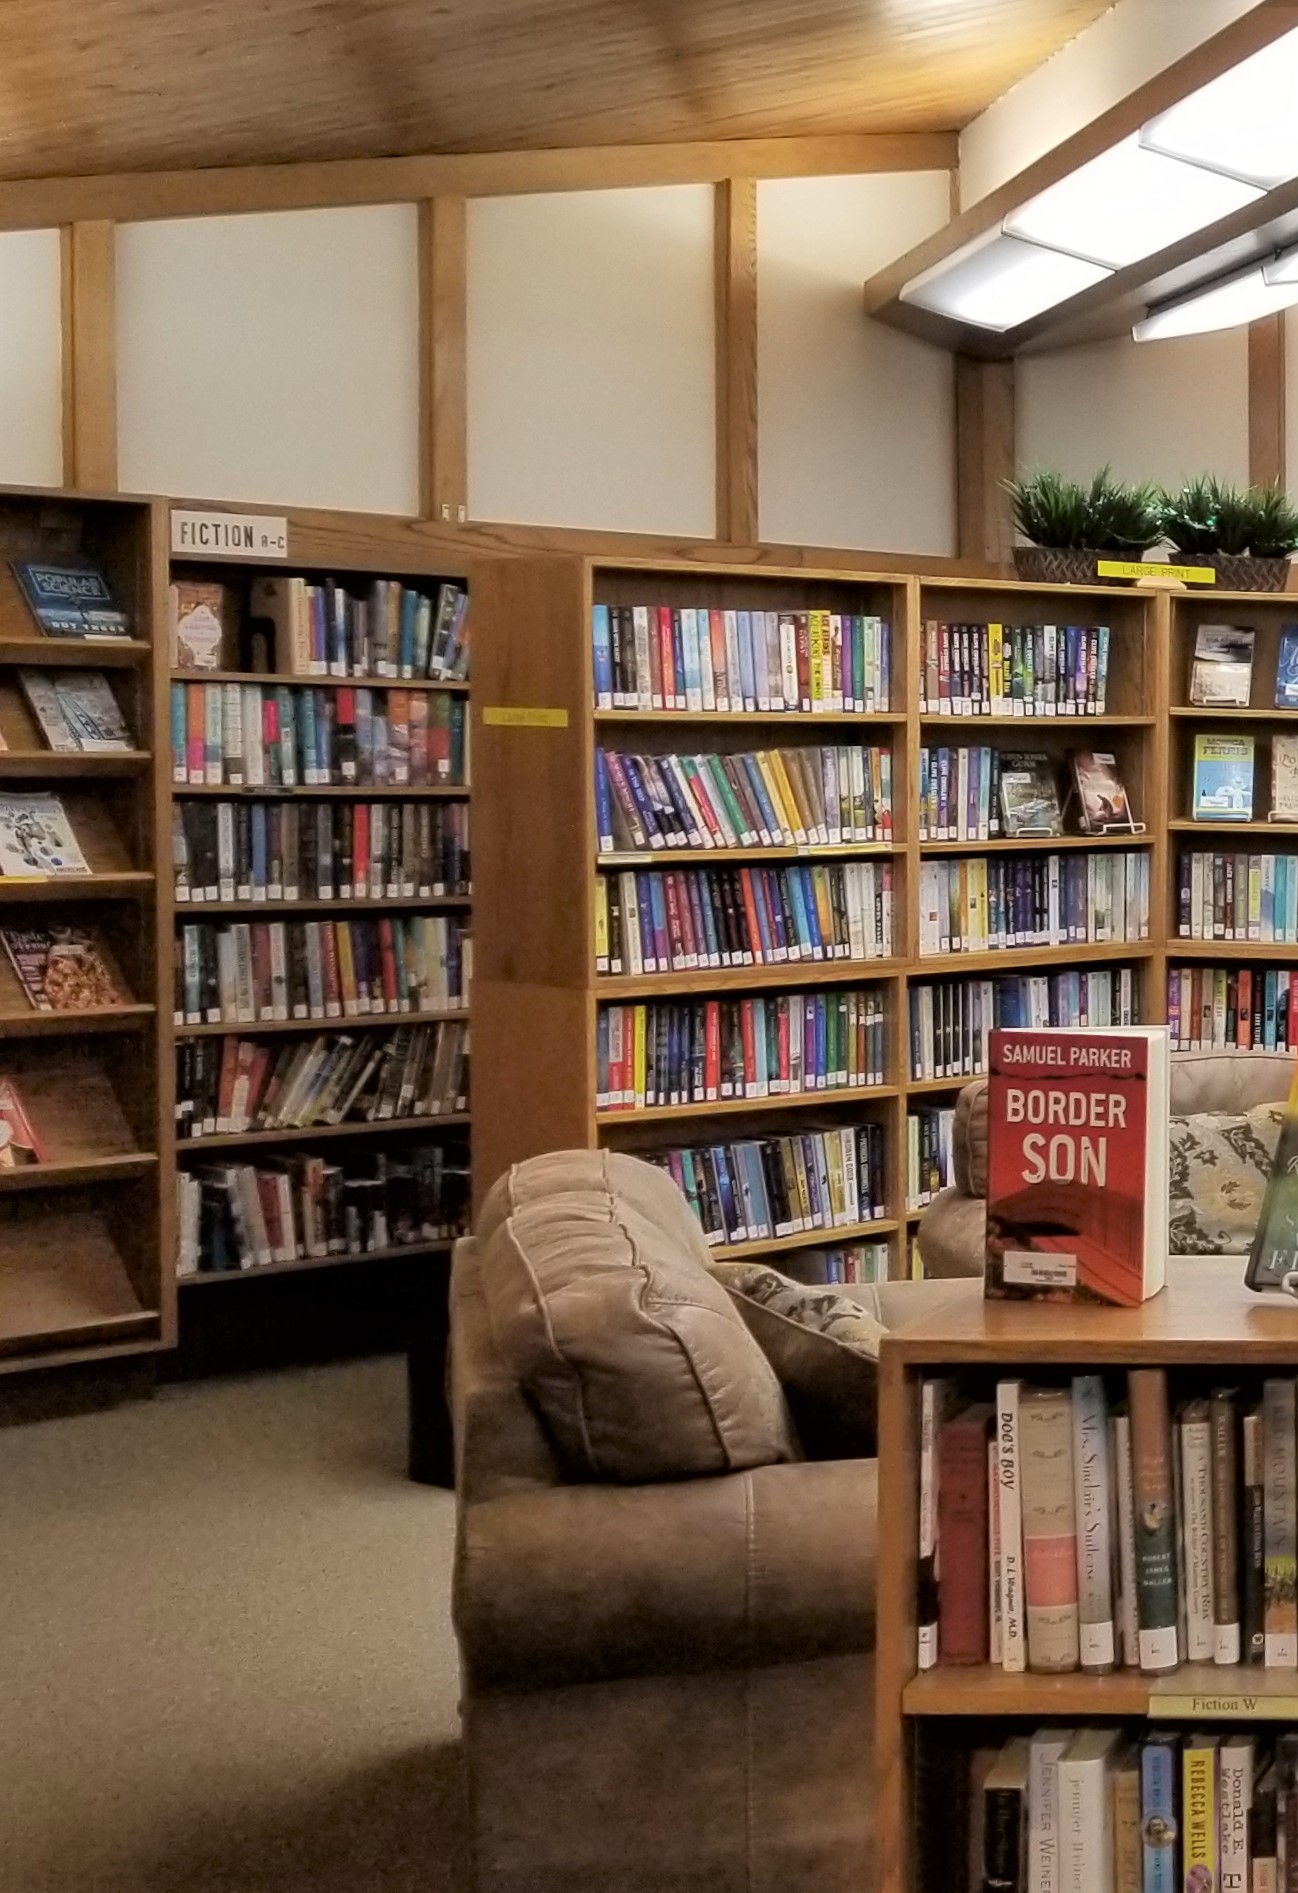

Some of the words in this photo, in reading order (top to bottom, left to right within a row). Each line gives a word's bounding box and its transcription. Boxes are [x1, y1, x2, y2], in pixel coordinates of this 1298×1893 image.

[180, 522, 253, 548] FICTION
[1003, 1044, 1066, 1065] SAMUEL
[1070, 1047, 1131, 1068] PARKER
[1007, 1088, 1126, 1128] BORDER
[1022, 1133, 1106, 1187] SON
[1000, 1459, 1016, 1490] BOY
[1191, 1697, 1237, 1711] Fiction
[1242, 1697, 1258, 1711] W
[1040, 1753, 1056, 1831] JENNIFER
[1191, 1760, 1206, 1816] REBECCA
[1233, 1768, 1244, 1830] Donald
[1221, 1768, 1231, 1854] Westlake
[1191, 1821, 1206, 1859] WELLS
[1233, 1838, 1244, 1855] E.
